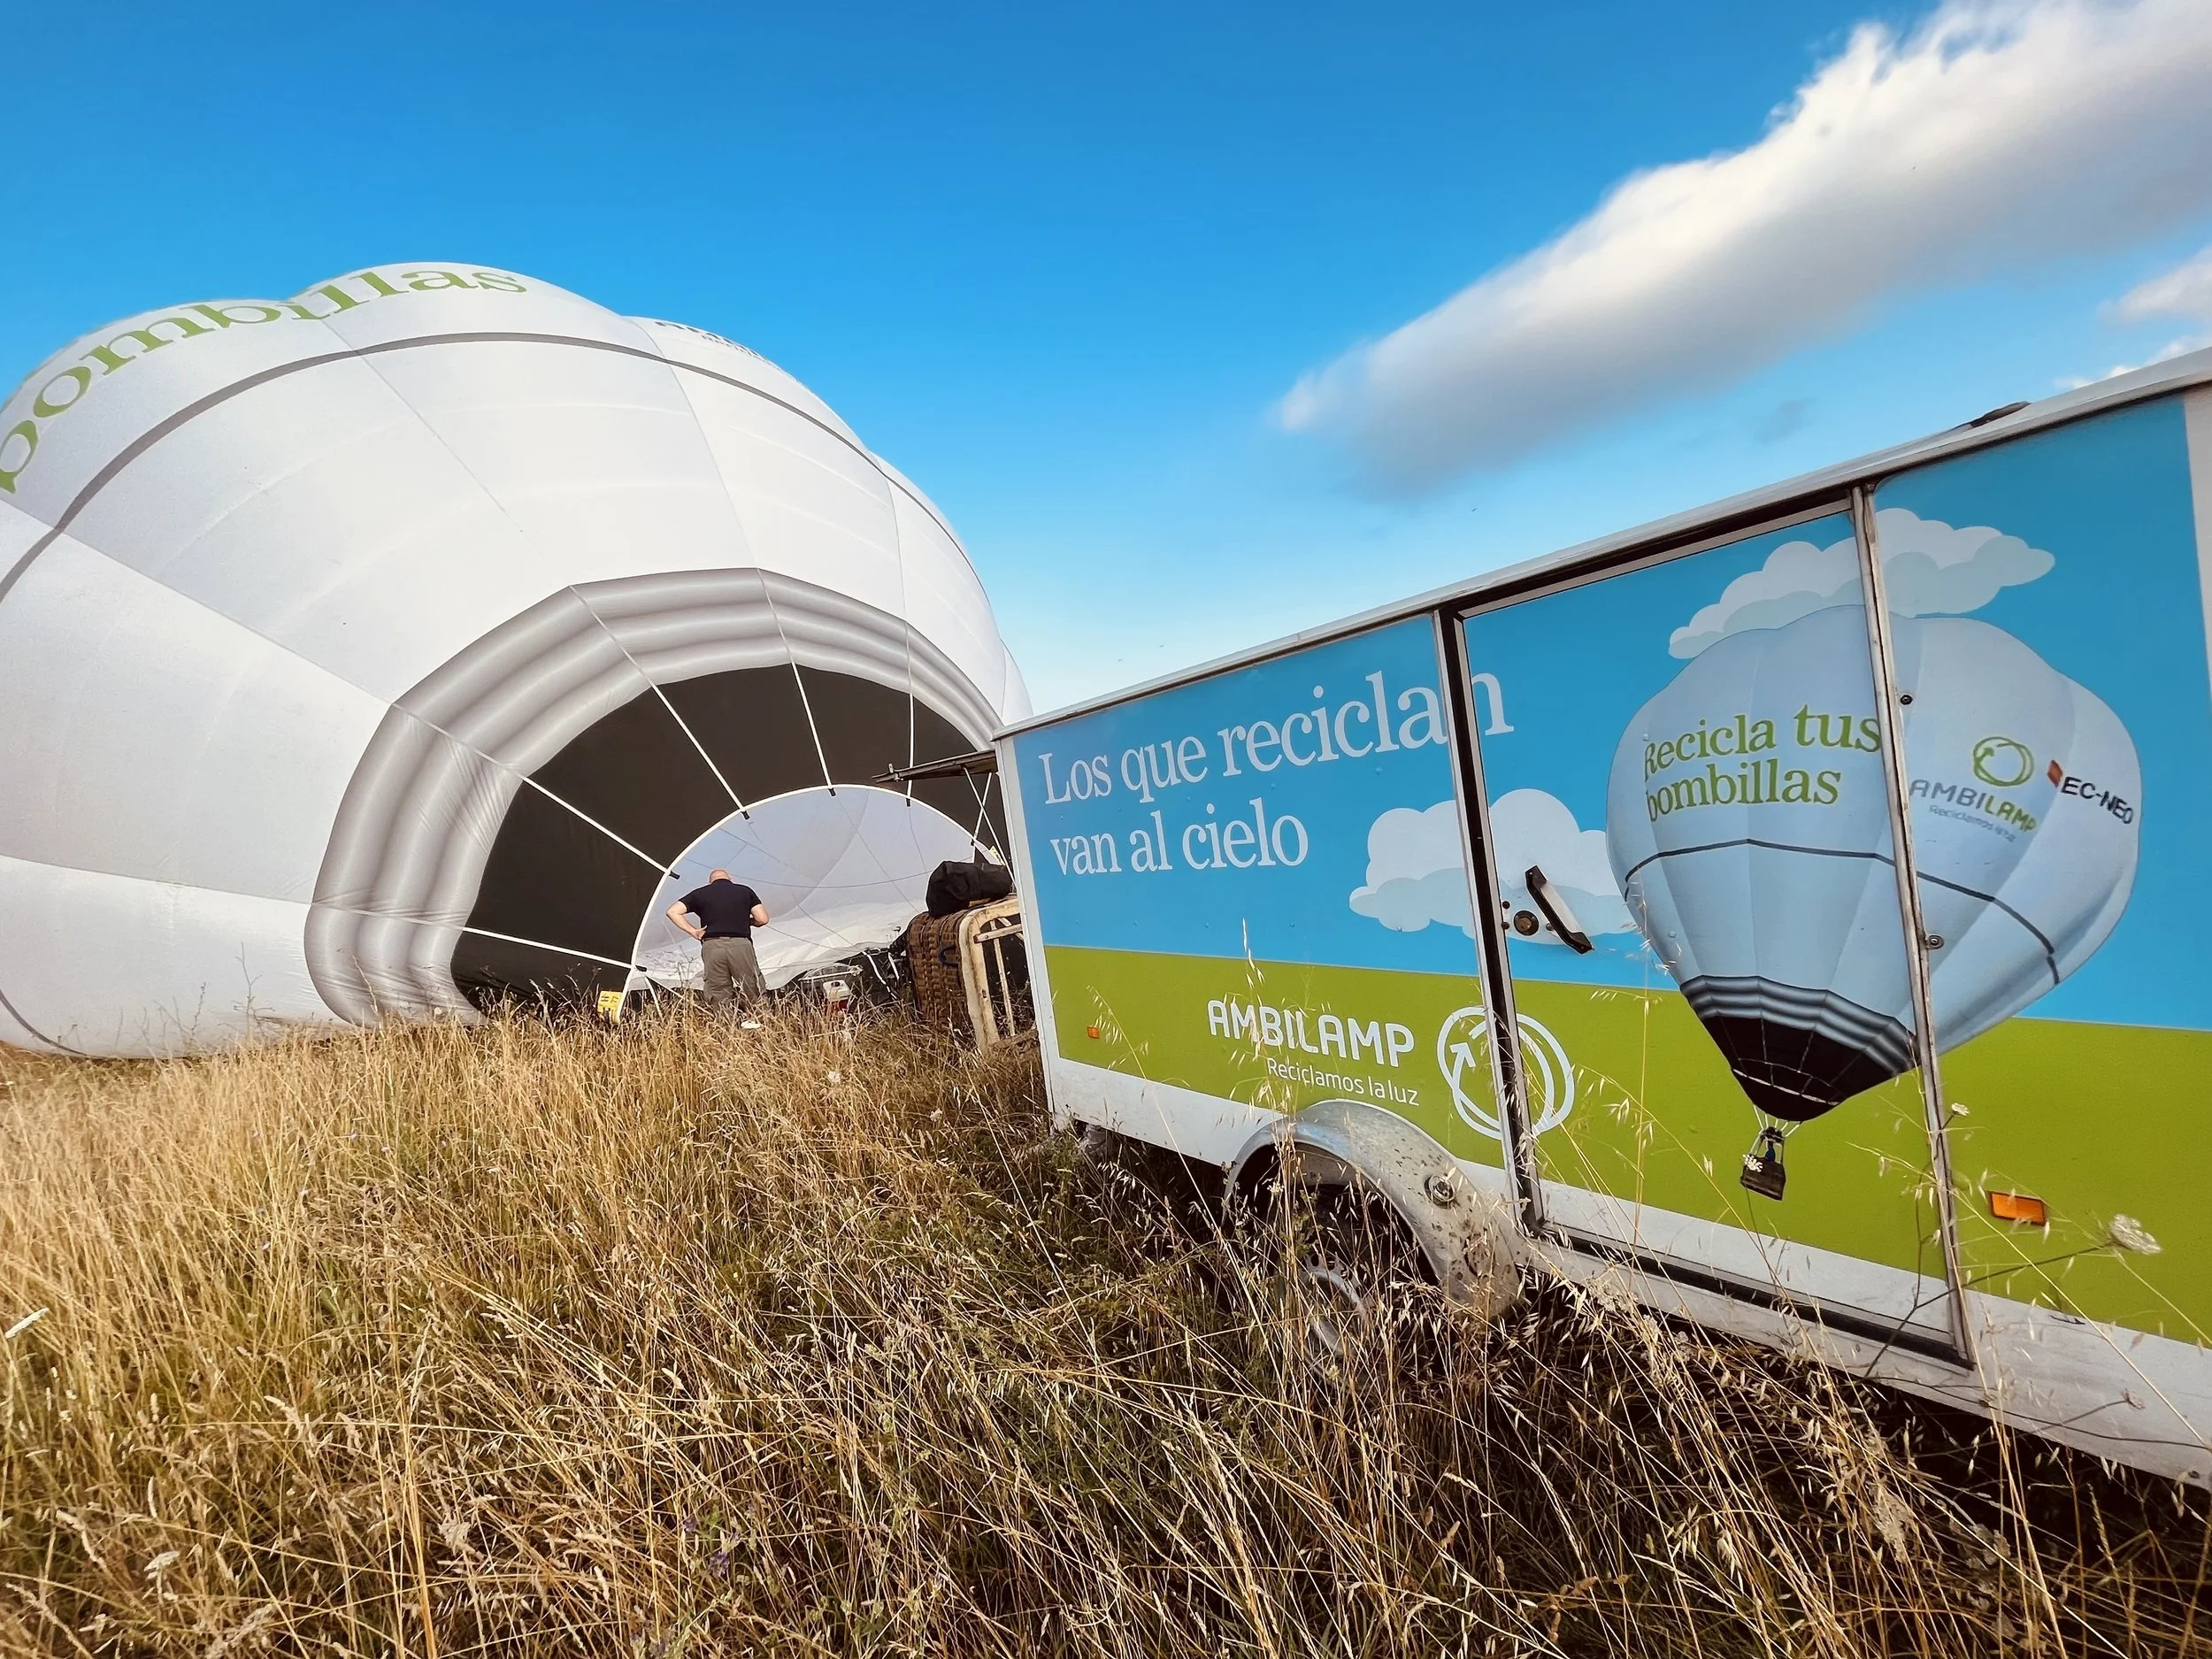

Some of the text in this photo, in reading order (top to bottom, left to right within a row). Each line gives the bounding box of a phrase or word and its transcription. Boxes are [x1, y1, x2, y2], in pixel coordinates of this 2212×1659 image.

[1039, 670, 1514, 804] Los que reciclan
[1644, 704, 1881, 783] Recicla tus
[1646, 758, 1841, 822] bombillas
[1909, 779, 2037, 833] AMBILAMP
[2061, 776, 2134, 824] EC-NEO
[1050, 797, 1310, 875] van al cielo
[1207, 1000, 1415, 1068] AMBILAMP
[1266, 1057, 1364, 1095] Reciclamos
